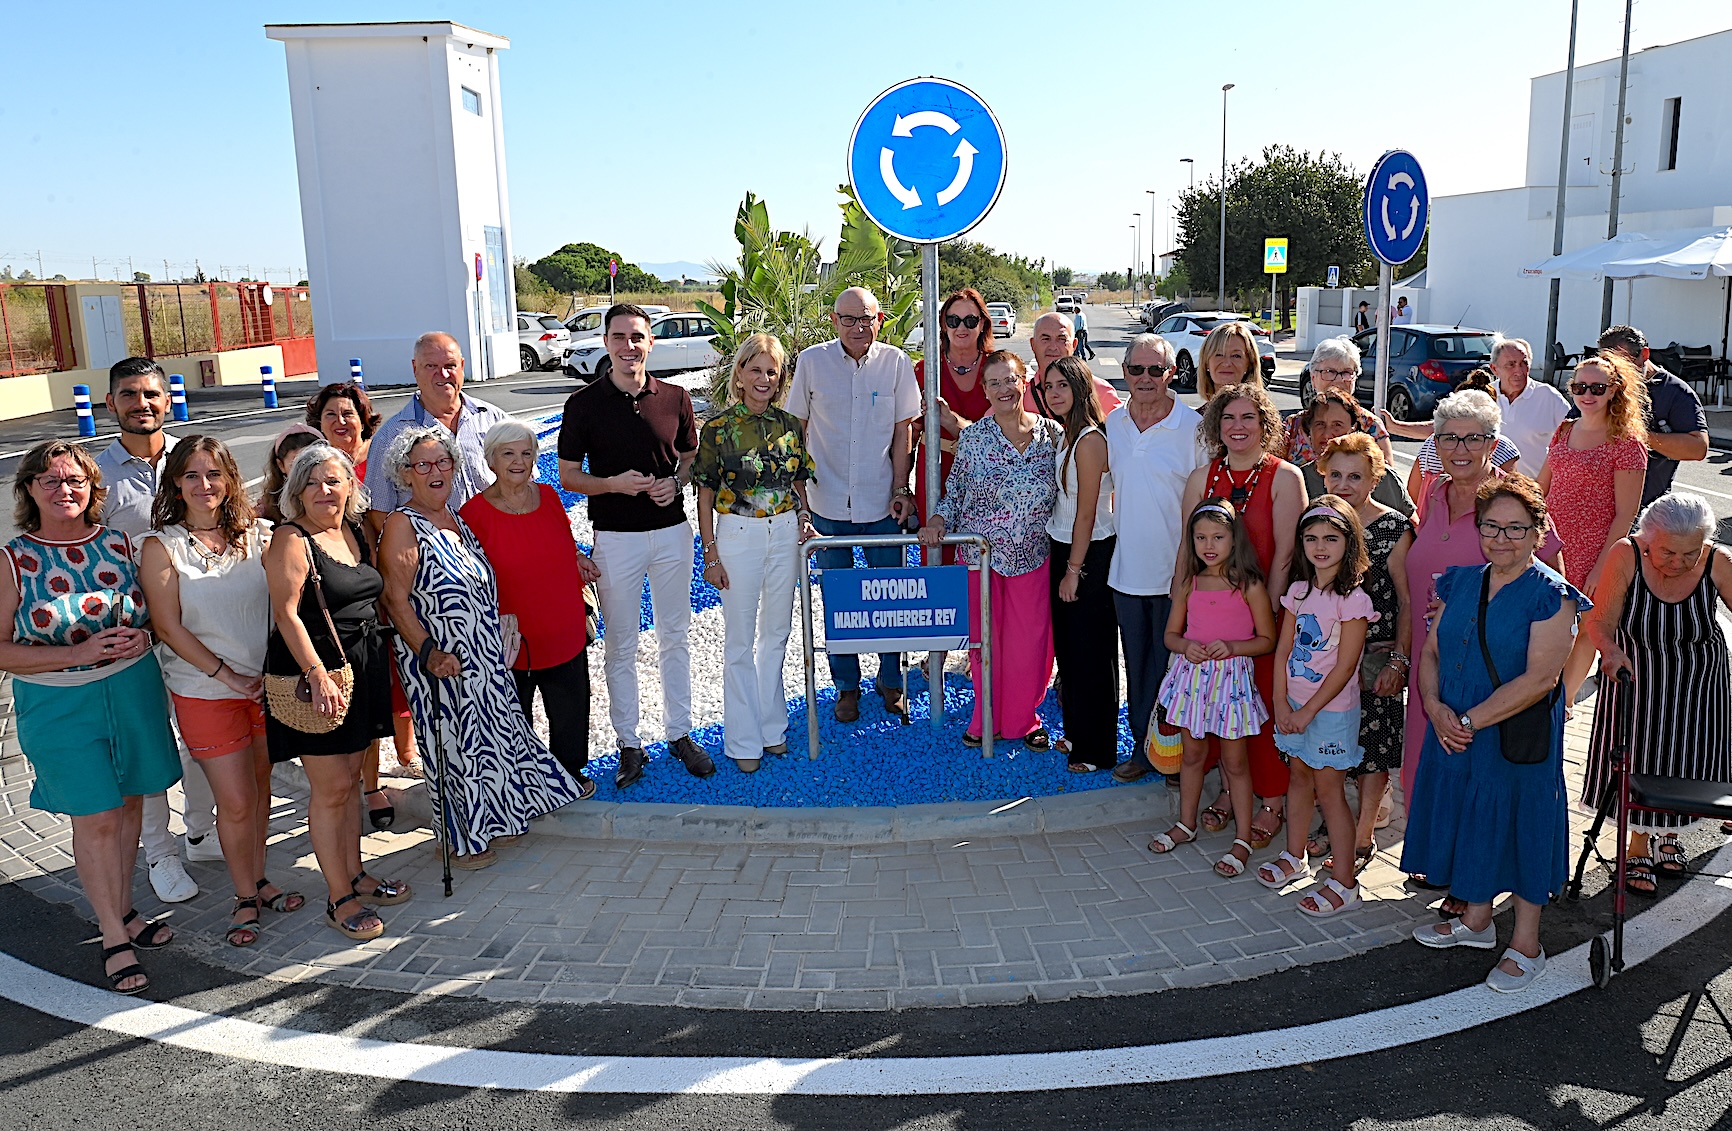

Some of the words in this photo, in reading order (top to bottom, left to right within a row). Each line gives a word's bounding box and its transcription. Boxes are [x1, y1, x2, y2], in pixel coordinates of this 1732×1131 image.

[861, 578, 927, 600] ROTONDA
[834, 611, 870, 629] MARIA
[872, 609, 932, 628] GUTIERREZ
[935, 608, 956, 626] REY
[1318, 747, 1346, 756] Stitch
